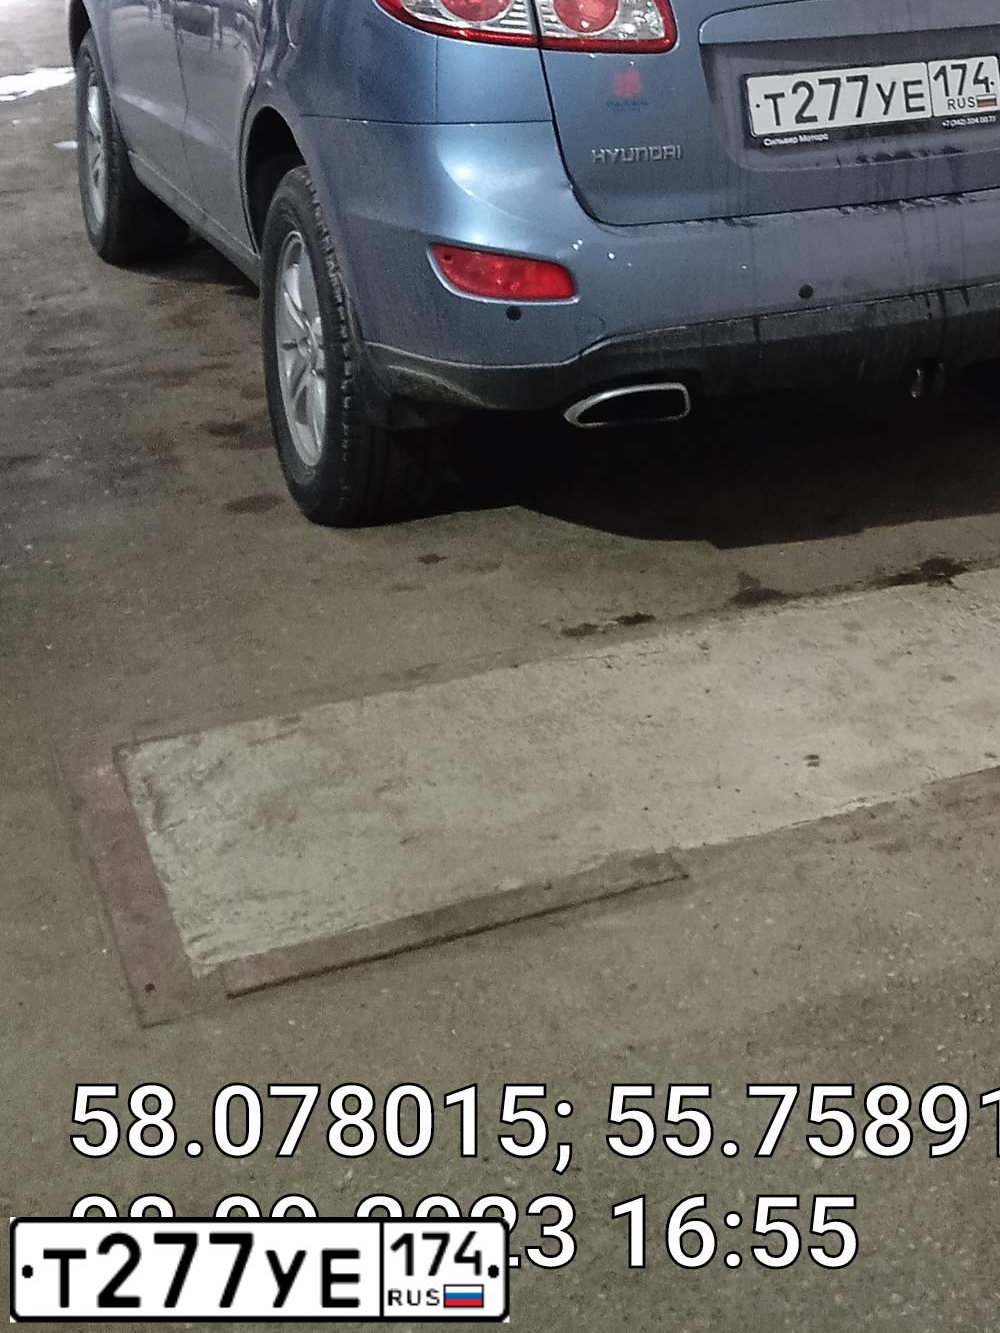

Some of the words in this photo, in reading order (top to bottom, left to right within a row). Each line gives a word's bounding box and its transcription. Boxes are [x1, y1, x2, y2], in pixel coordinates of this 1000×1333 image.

[764, 74, 926, 126] Т277УЕ
[933, 61, 990, 98] 174
[947, 97, 976, 110] RUS
[591, 145, 681, 164] HYUNDAI
